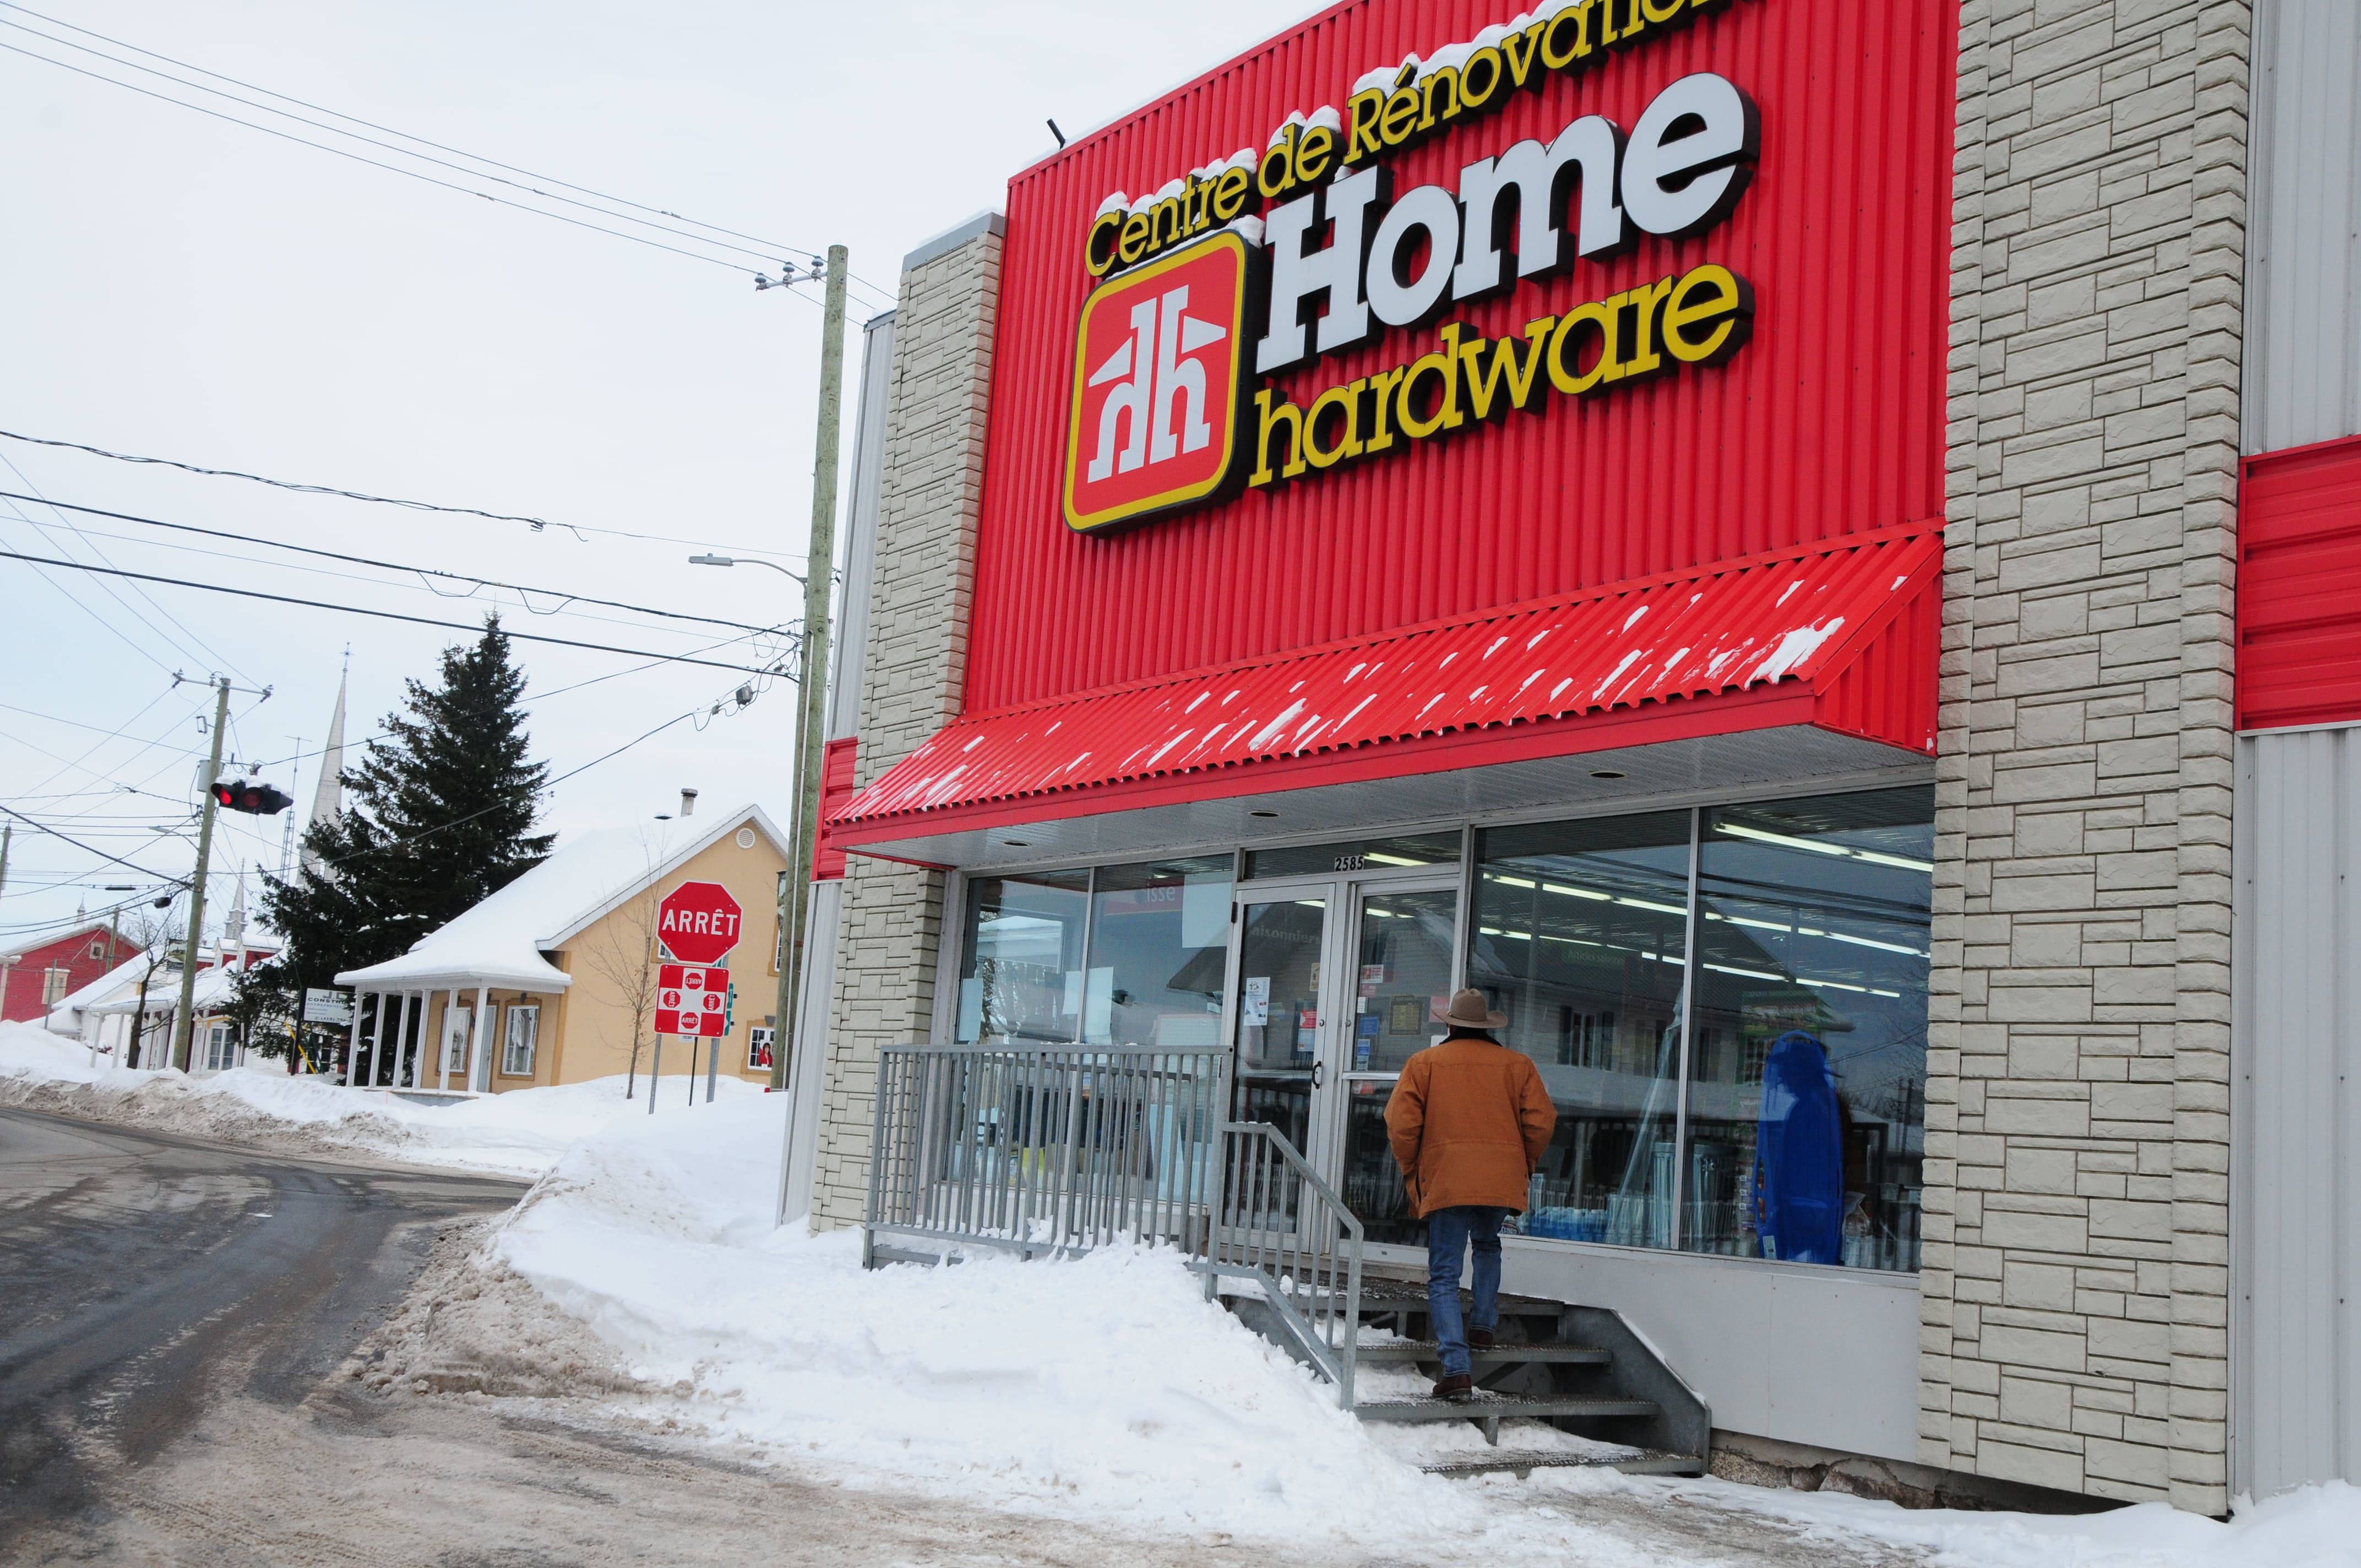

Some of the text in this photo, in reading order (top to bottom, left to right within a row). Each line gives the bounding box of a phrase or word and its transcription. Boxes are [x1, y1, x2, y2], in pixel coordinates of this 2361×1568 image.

[1085, 165, 1247, 277] Centre
[1258, 123, 1332, 199] de
[1256, 72, 1745, 375] Home
[1249, 263, 1739, 488] hardware
[662, 908, 738, 936] ARRÊT
[1335, 856, 1363, 872] 2585
